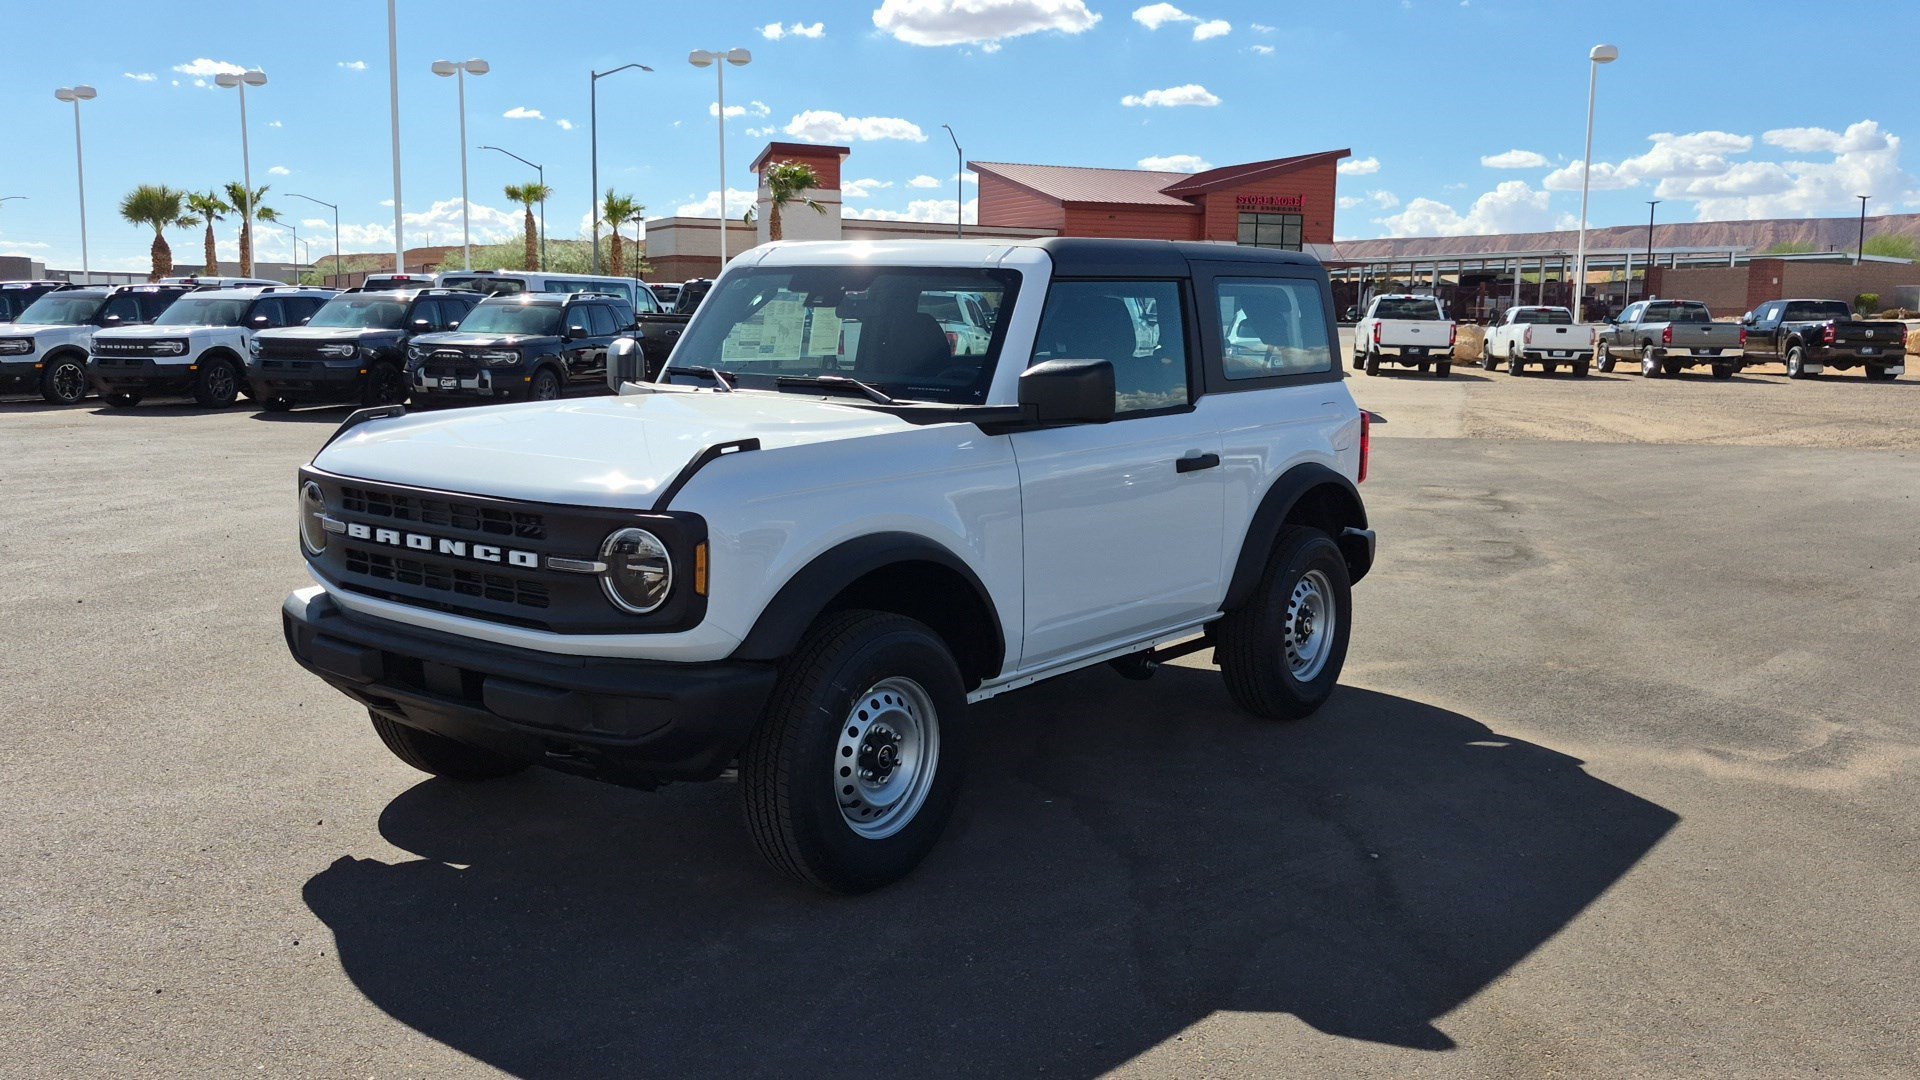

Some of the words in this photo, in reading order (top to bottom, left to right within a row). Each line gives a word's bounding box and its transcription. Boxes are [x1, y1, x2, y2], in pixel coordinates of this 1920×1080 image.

[1238, 194, 1268, 205] STORE
[1271, 195, 1300, 206] MORE
[348, 523, 539, 568] BRONCO
